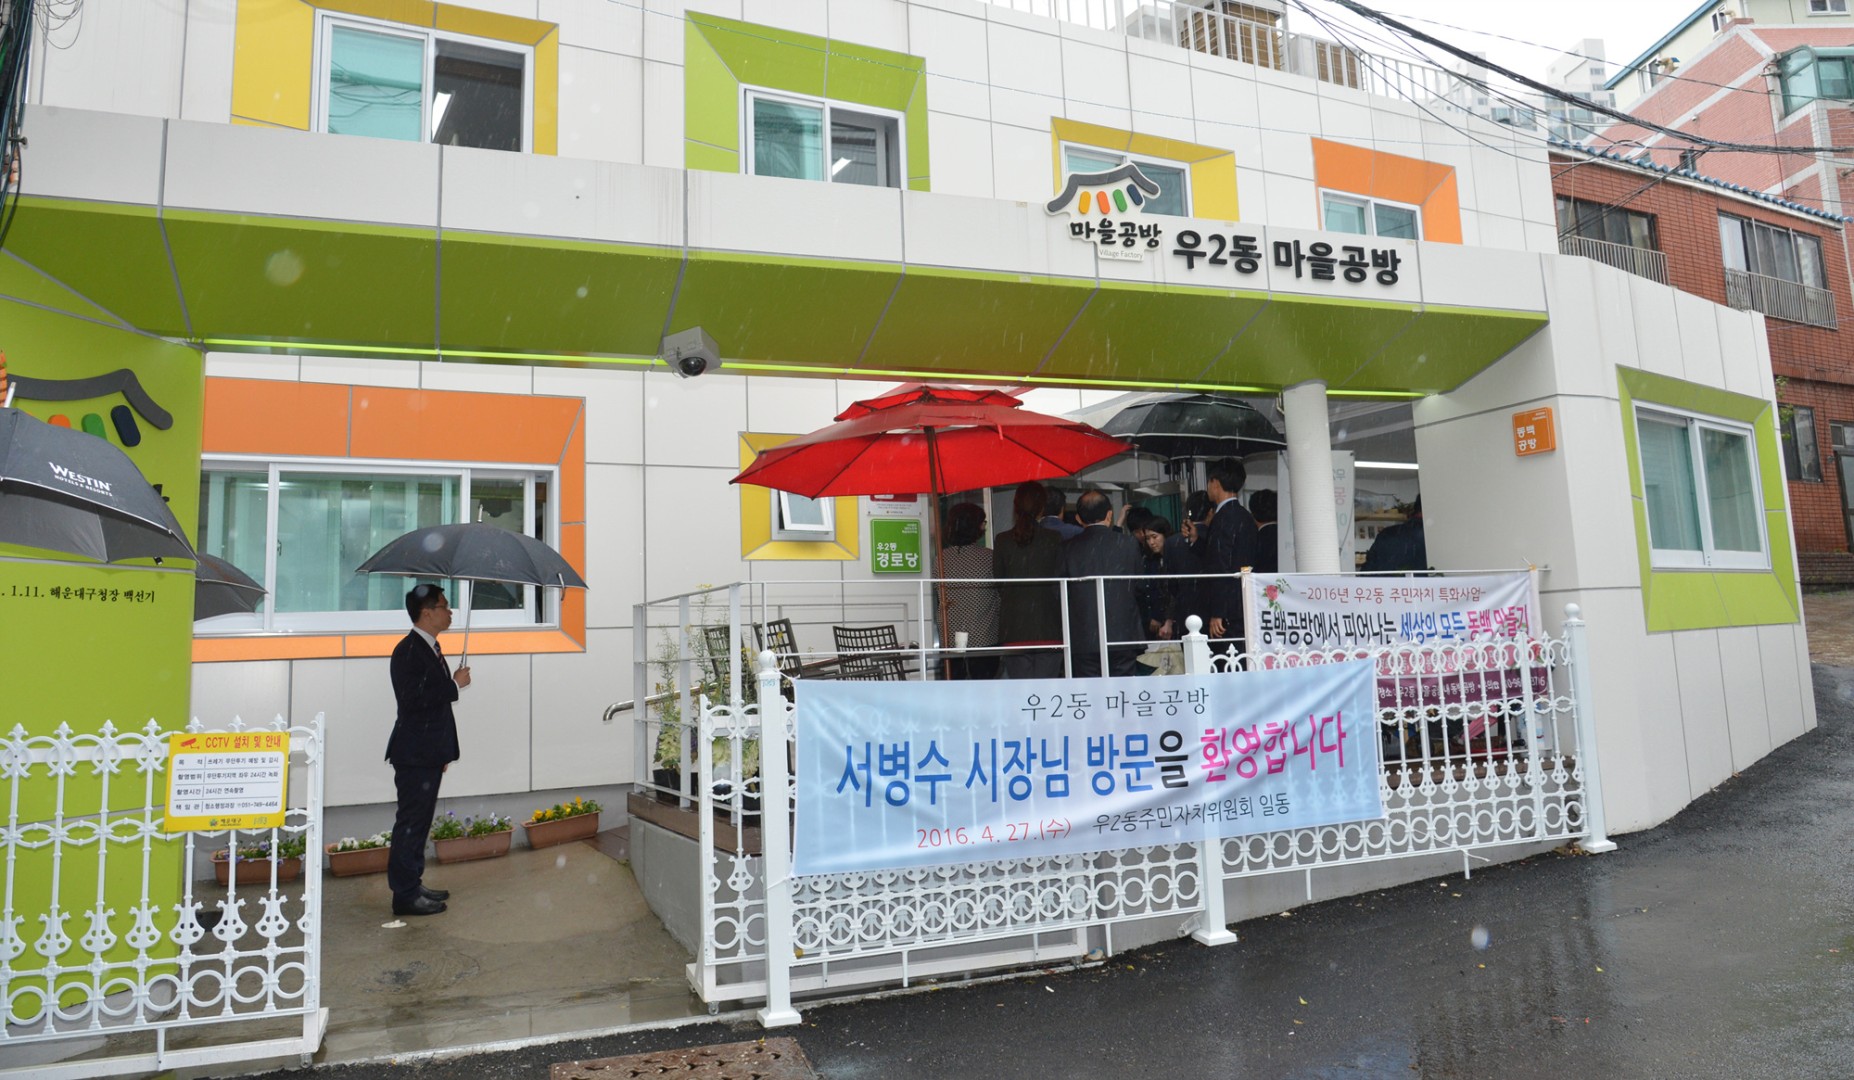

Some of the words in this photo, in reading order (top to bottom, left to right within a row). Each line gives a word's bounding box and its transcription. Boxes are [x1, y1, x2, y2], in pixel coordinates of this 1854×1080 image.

[1070, 218, 1162, 248] 마을공방
[1099, 249, 1120, 258] Village
[1121, 250, 1143, 260] Factory
[1173, 230, 1262, 274] 우2동
[1274, 240, 1401, 286] 마을공방
[1518, 438, 1536, 451] 공방
[49, 461, 110, 491] WESTIN
[877, 542, 897, 552] 우2동
[877, 552, 919, 568] 경로당
[50, 586, 120, 602] 해운대구청장
[124, 589, 155, 603] 백선기
[1354, 587, 1384, 604] 우2동
[1389, 587, 1434, 604] 주민자치
[1260, 610, 1341, 645] 동백공방에서
[1342, 612, 1397, 645] 피어나는
[1400, 611, 1438, 645] 세상의
[1440, 611, 1466, 642] 모든
[1467, 609, 1494, 642] 동백
[1493, 604, 1529, 639] 만들기
[1021, 691, 1092, 721] 우2동
[1105, 687, 1210, 718] 마을공방
[205, 736, 230, 749] CCTV
[234, 736, 250, 749] 설치
[254, 736, 262, 748] 및
[265, 735, 281, 748] 안내
[835, 738, 952, 808] 서병수
[965, 736, 1071, 802] 시장님
[1087, 730, 1190, 797] 방문을
[1200, 710, 1347, 784] 환영합니다
[250, 771, 267, 779] 24시간
[206, 787, 222, 795] 24시간
[1092, 799, 1254, 835] 우2동주민자치위원회
[1258, 793, 1291, 817] 일동
